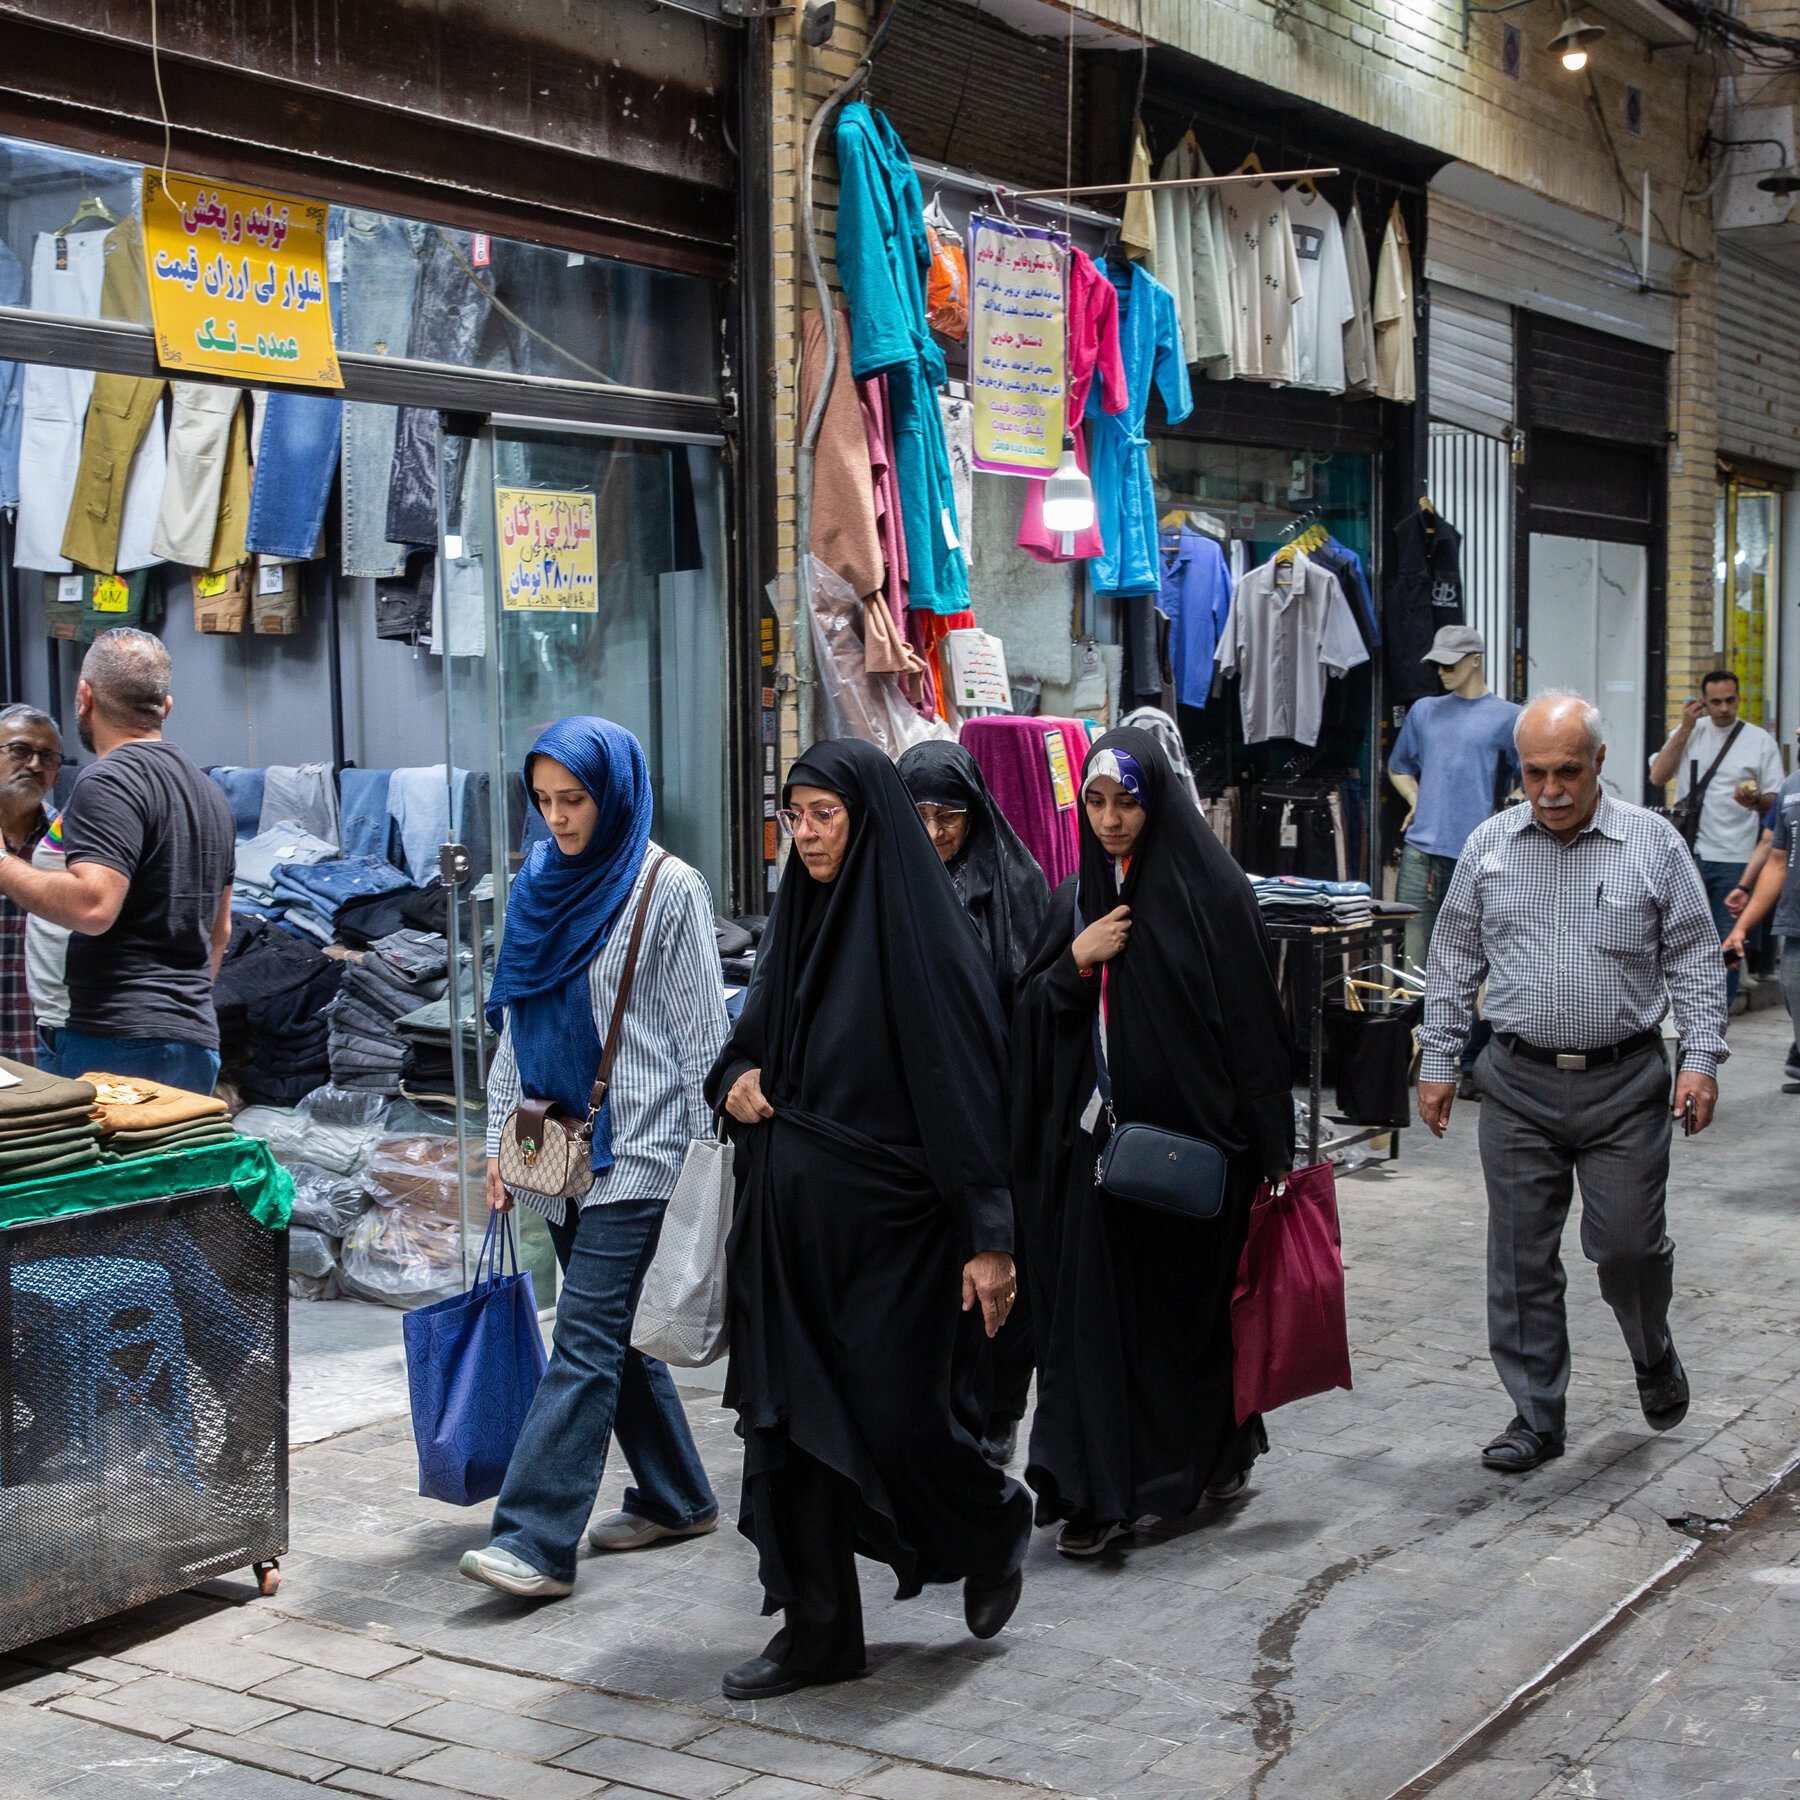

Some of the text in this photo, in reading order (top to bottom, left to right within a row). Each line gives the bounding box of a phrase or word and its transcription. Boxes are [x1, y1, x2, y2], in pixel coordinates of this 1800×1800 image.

[182, 192, 289, 250] تولید و پخش
[154, 247, 323, 310] شلوار لی ارزان قیمت
[196, 317, 238, 352] تک
[257, 334, 299, 361] عمده
[533, 518, 541, 548] و
[543, 504, 561, 548] لی
[562, 506, 592, 549] شلوار
[509, 561, 541, 596] تومان
